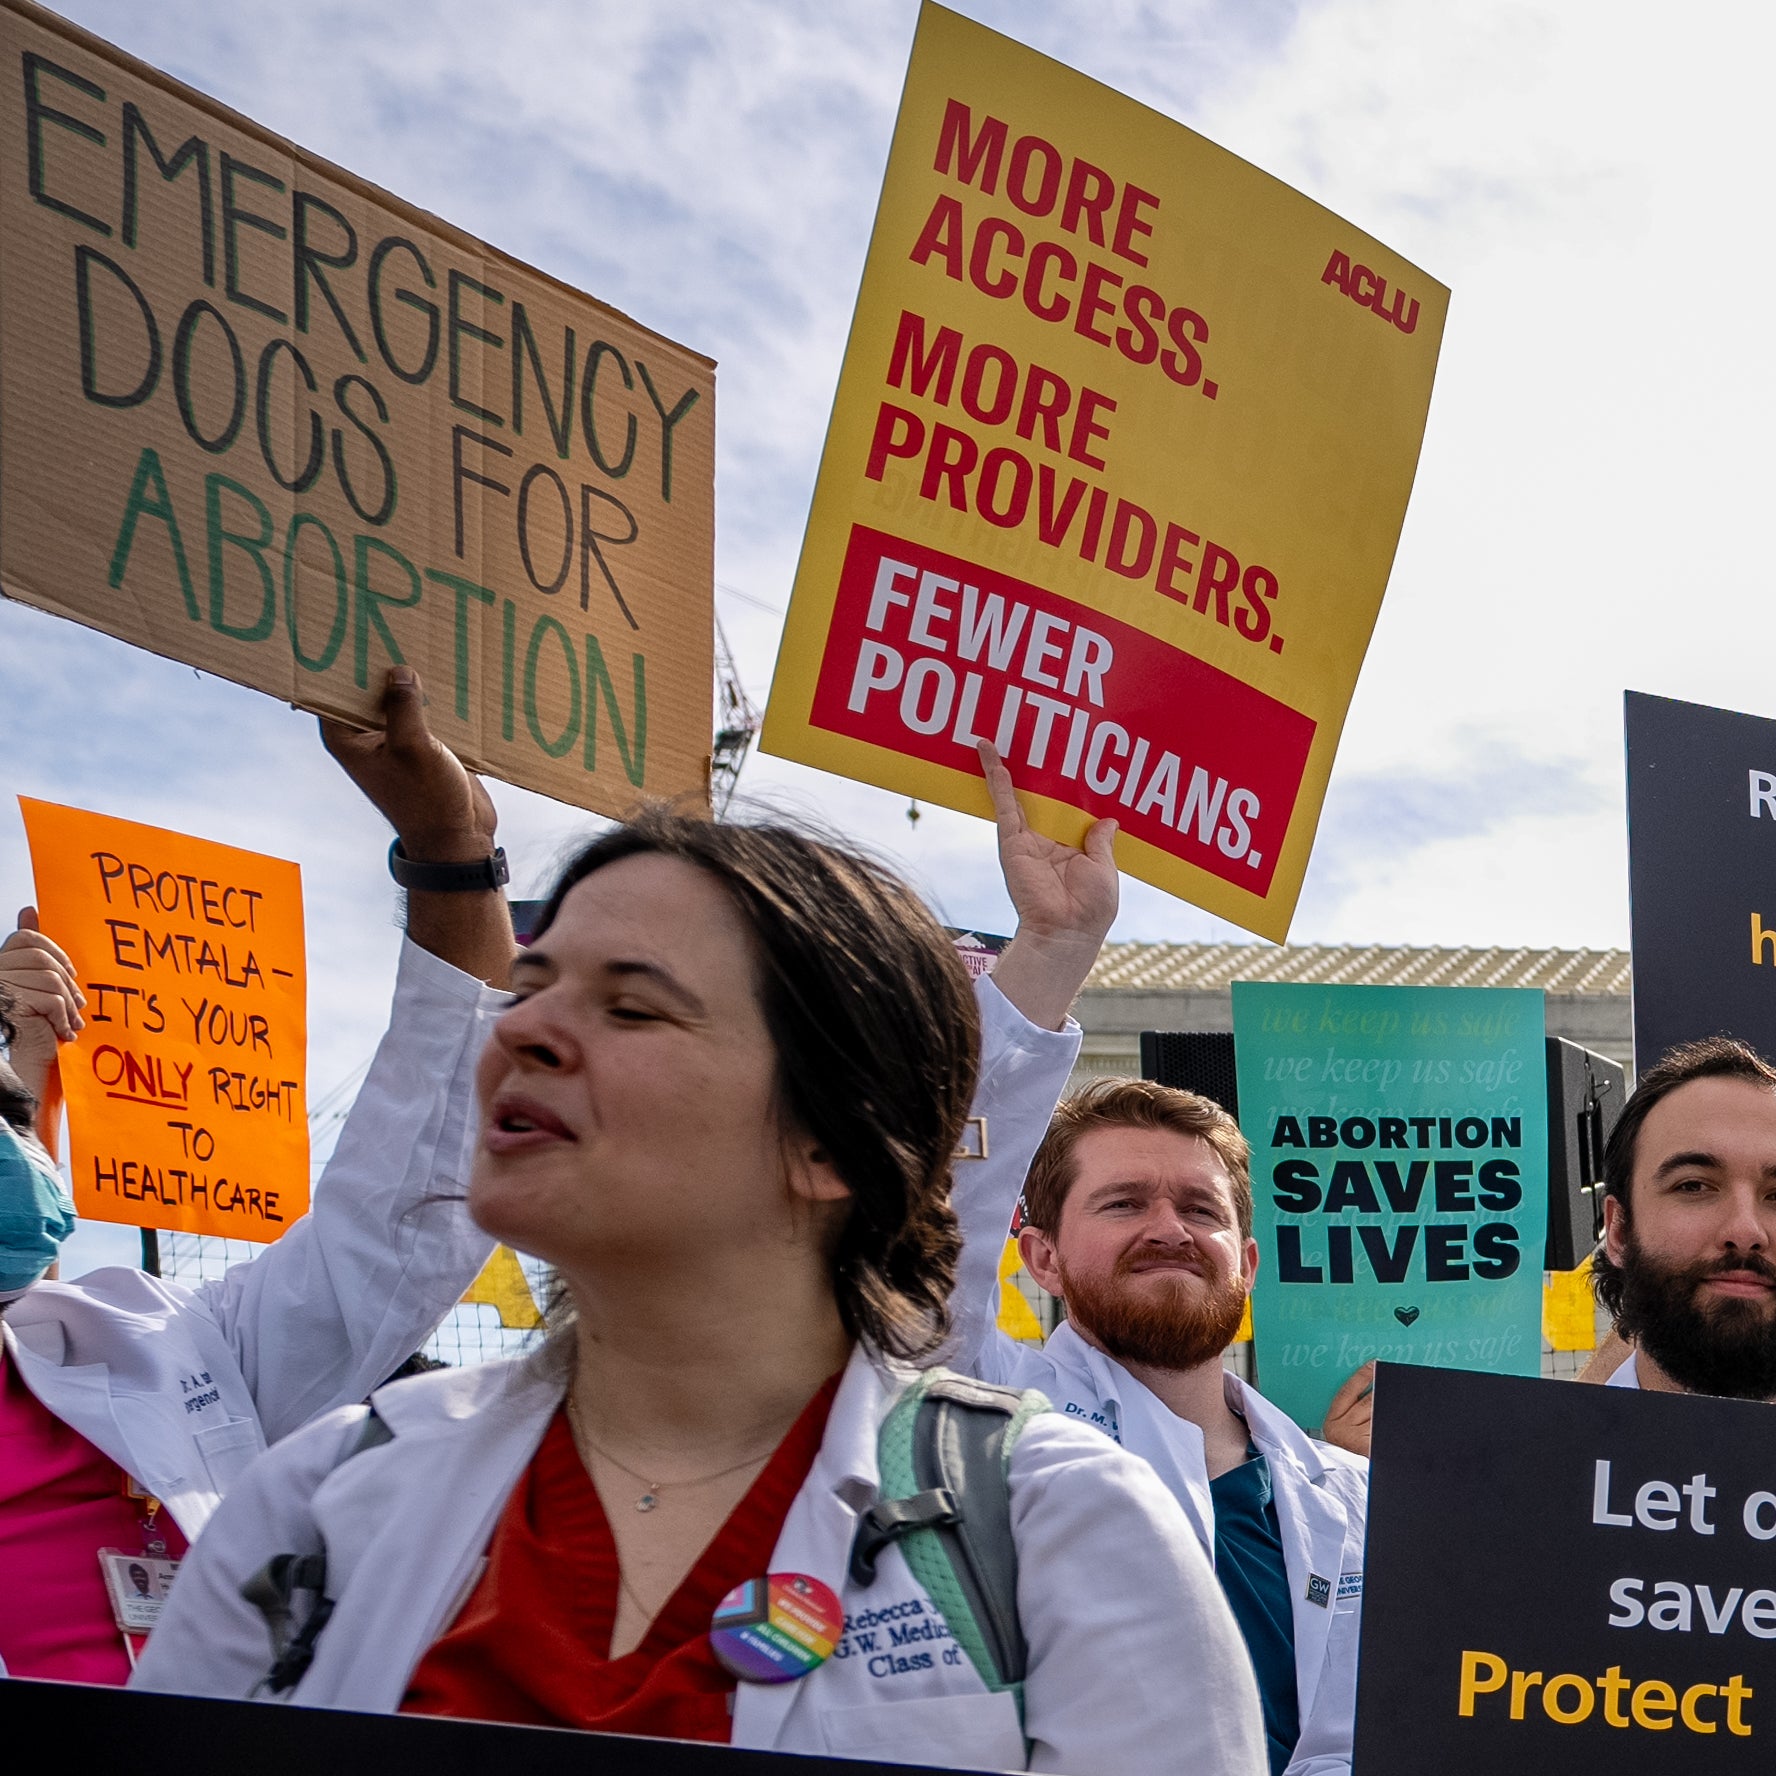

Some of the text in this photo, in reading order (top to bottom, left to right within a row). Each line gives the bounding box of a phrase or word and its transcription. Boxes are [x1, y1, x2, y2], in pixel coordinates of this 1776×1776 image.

[934, 98, 1160, 268] MORE
[22, 50, 700, 501] EMERGENCY
[909, 194, 1219, 400] ACCESS.
[1320, 249, 1420, 334] ACLU
[885, 310, 1118, 472] MORE
[75, 246, 396, 526] DOCS
[450, 424, 640, 630] FOR
[865, 401, 1285, 654] PROVIDERS.
[109, 448, 646, 788] ABORTION
[866, 556, 1113, 708] FEWER
[847, 639, 1262, 869] POLITICIANS.
[91, 851, 262, 933] PROTECT
[87, 983, 272, 1059] IT'S YOUR
[92, 1044, 298, 1122] ONLY RIGHT
[168, 1122, 215, 1161] TO
[1271, 1116, 1521, 1149] ABORTION
[1273, 1159, 1523, 1214] SAVES
[1277, 1223, 1521, 1284] LIVES
[1065, 1402, 1108, 1427] Dr. M.
[1593, 1459, 1716, 1535] Let
[1310, 1577, 1329, 1593] GW
[867, 1643, 962, 1678] Class of
[1459, 1650, 1752, 1736] Protect
